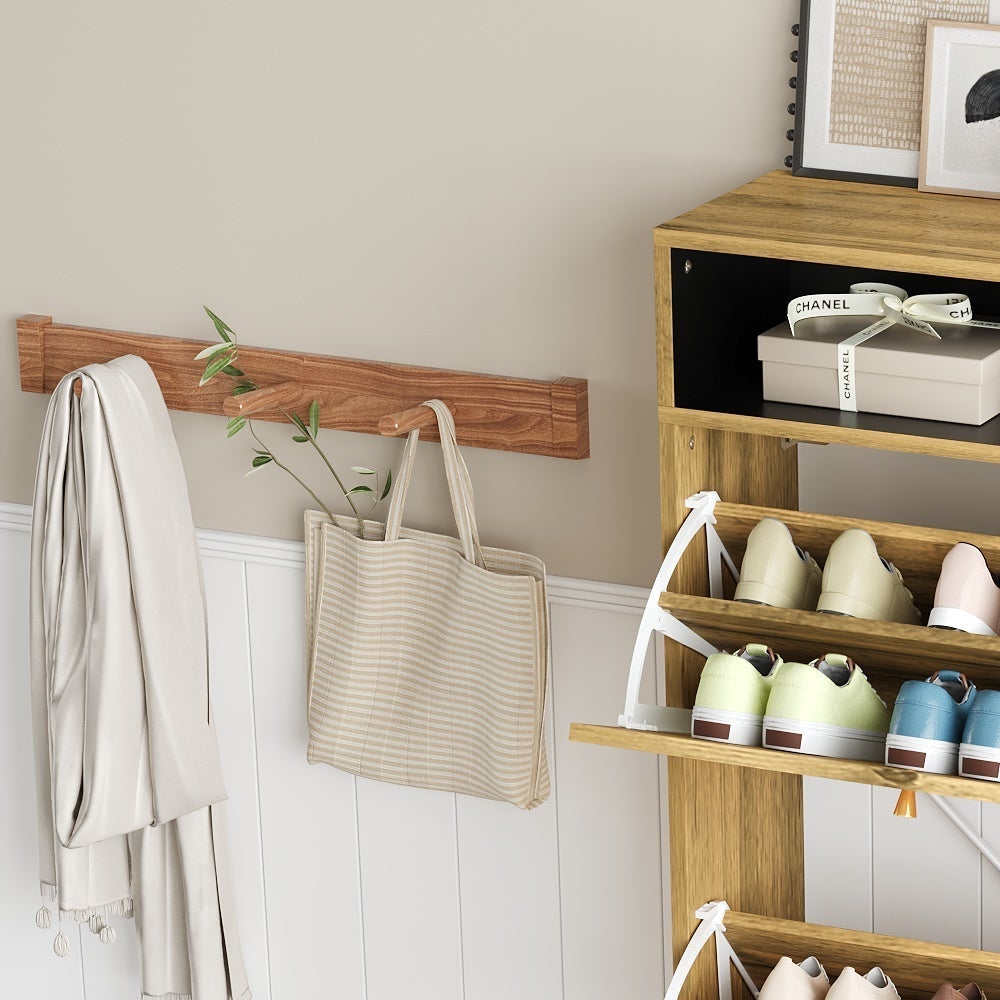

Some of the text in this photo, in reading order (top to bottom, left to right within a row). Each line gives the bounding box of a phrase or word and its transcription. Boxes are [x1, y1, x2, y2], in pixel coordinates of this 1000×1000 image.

[796, 299, 850, 314] CHANEL
[949, 307, 972, 319] CH
[842, 349, 851, 399] CHANEL
